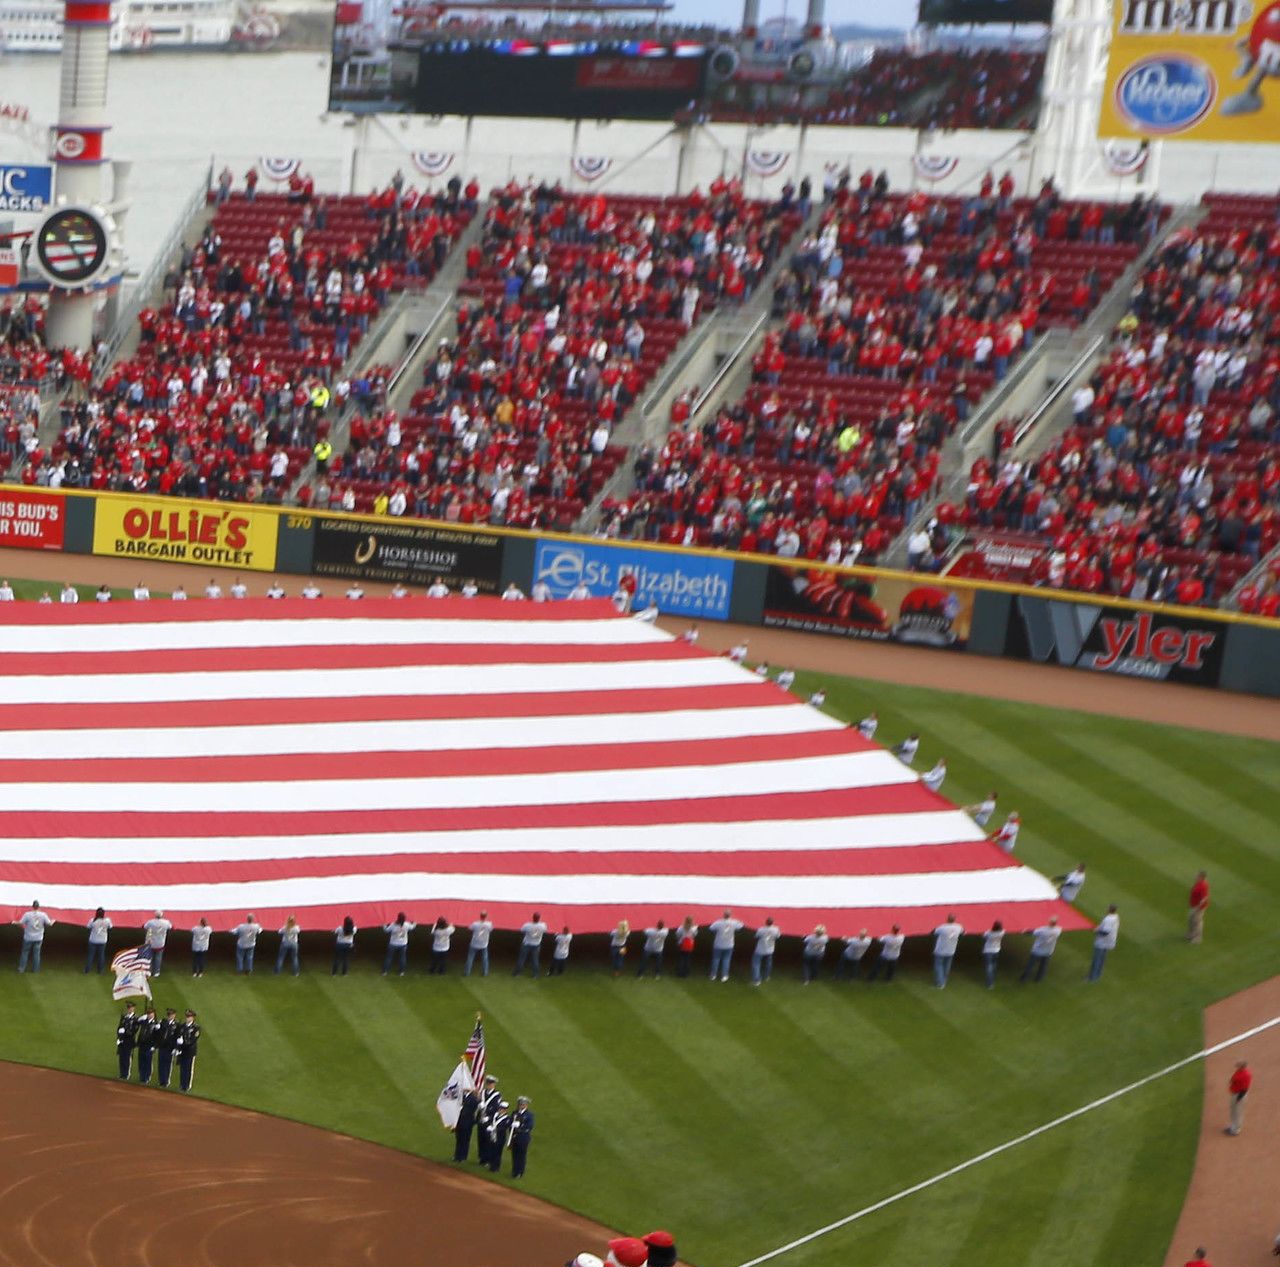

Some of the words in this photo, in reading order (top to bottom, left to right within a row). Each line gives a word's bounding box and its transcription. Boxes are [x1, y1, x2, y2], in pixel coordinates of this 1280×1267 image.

[1128, 62, 1206, 121] Kroger
[17, 503, 59, 522] BUD'S
[11, 519, 44, 536] YOU.
[114, 539, 187, 559] BARGAIN
[191, 546, 254, 565] OUTLET
